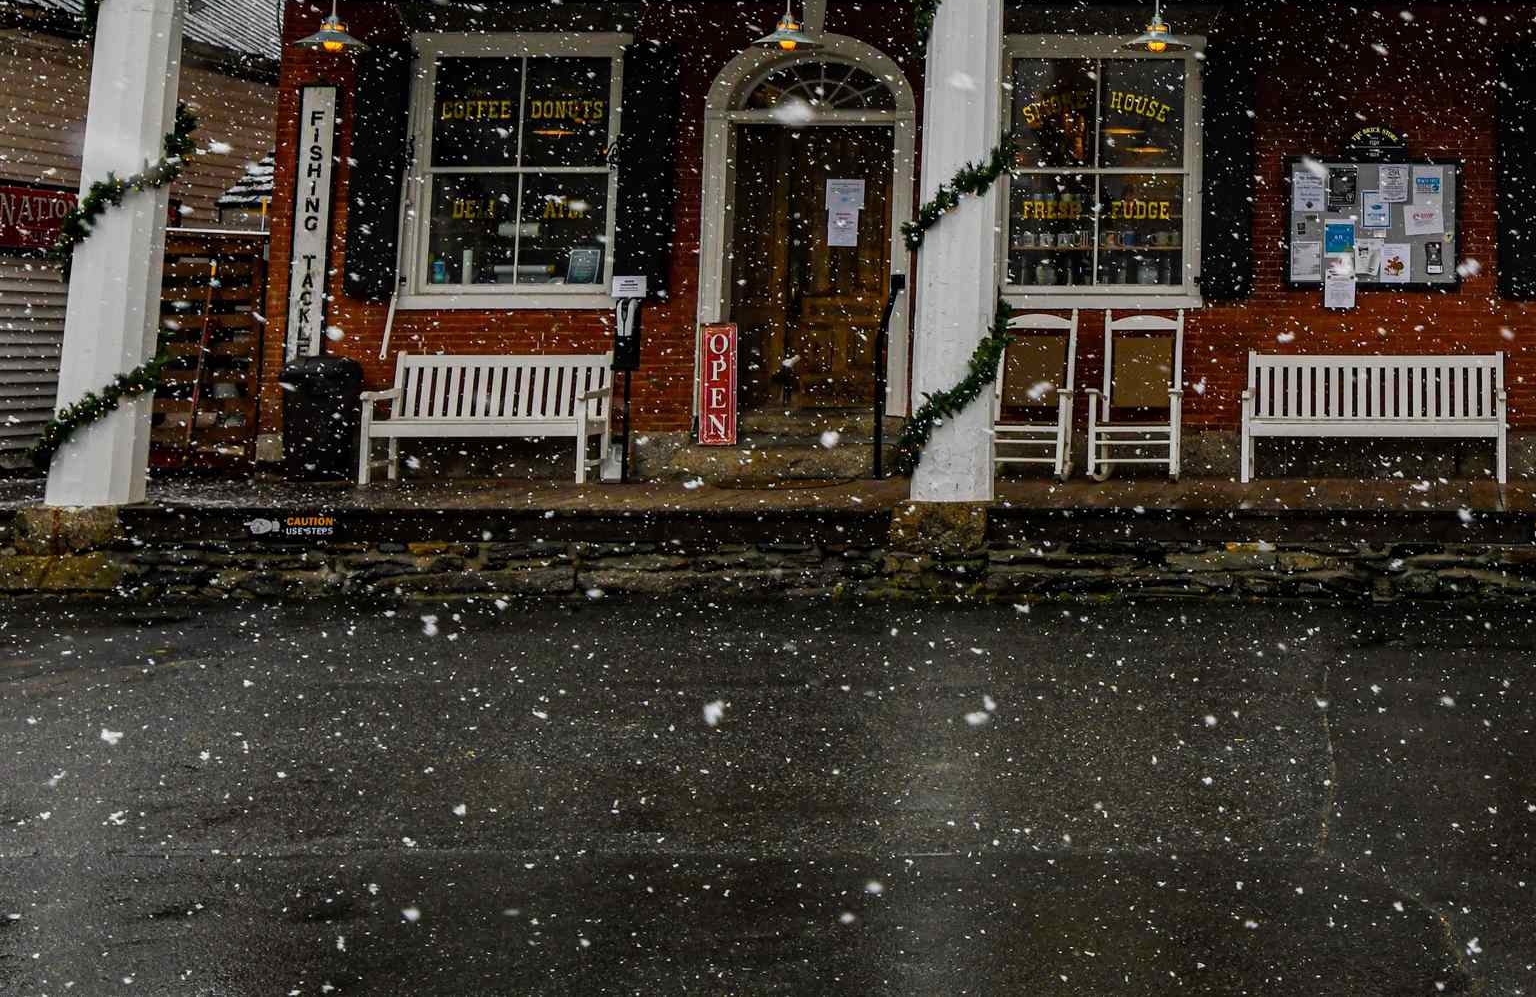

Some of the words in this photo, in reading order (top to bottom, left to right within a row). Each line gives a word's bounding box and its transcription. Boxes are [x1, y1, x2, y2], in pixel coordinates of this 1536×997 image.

[442, 101, 512, 120] COFFEE
[531, 101, 604, 119] DONUTS
[1110, 91, 1171, 123] HOUSE
[304, 111, 325, 231] FISHING
[1023, 202, 1082, 220] FRESH
[1111, 202, 1170, 220] FUDGE
[297, 255, 316, 354] TACKLE
[709, 333, 729, 437] OPEN
[286, 527, 303, 535] USE
[307, 527, 334, 535] STEPS
[287, 517, 334, 526] CAUTION
